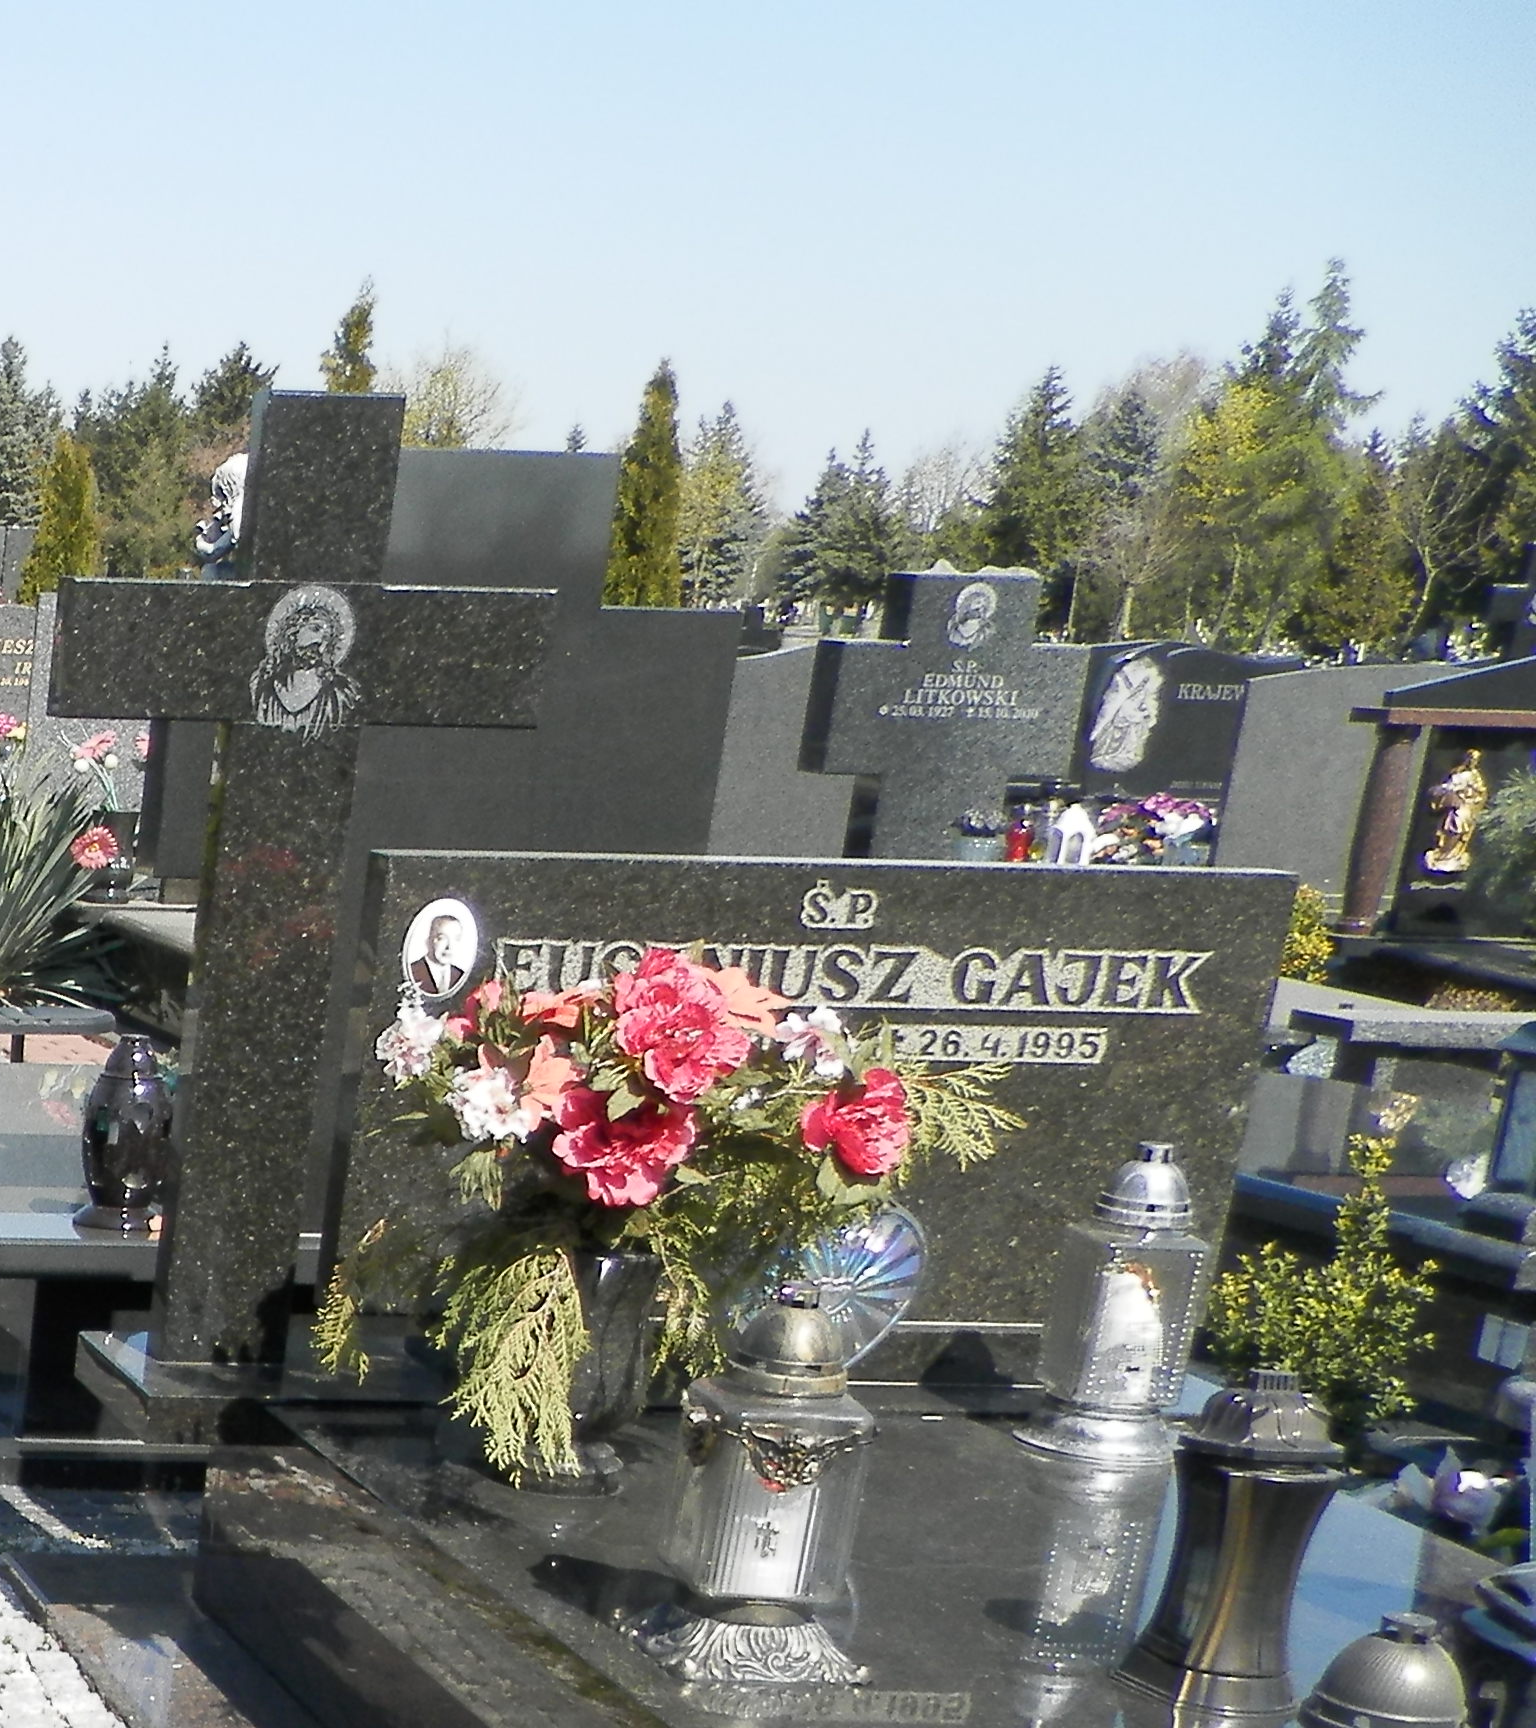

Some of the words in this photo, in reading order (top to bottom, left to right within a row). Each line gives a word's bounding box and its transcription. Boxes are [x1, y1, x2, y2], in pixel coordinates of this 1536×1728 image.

[922, 673, 1005, 689] EDMUND
[901, 688, 1020, 706] LITKOWSKI
[946, 949, 1204, 1012] GAJEK
